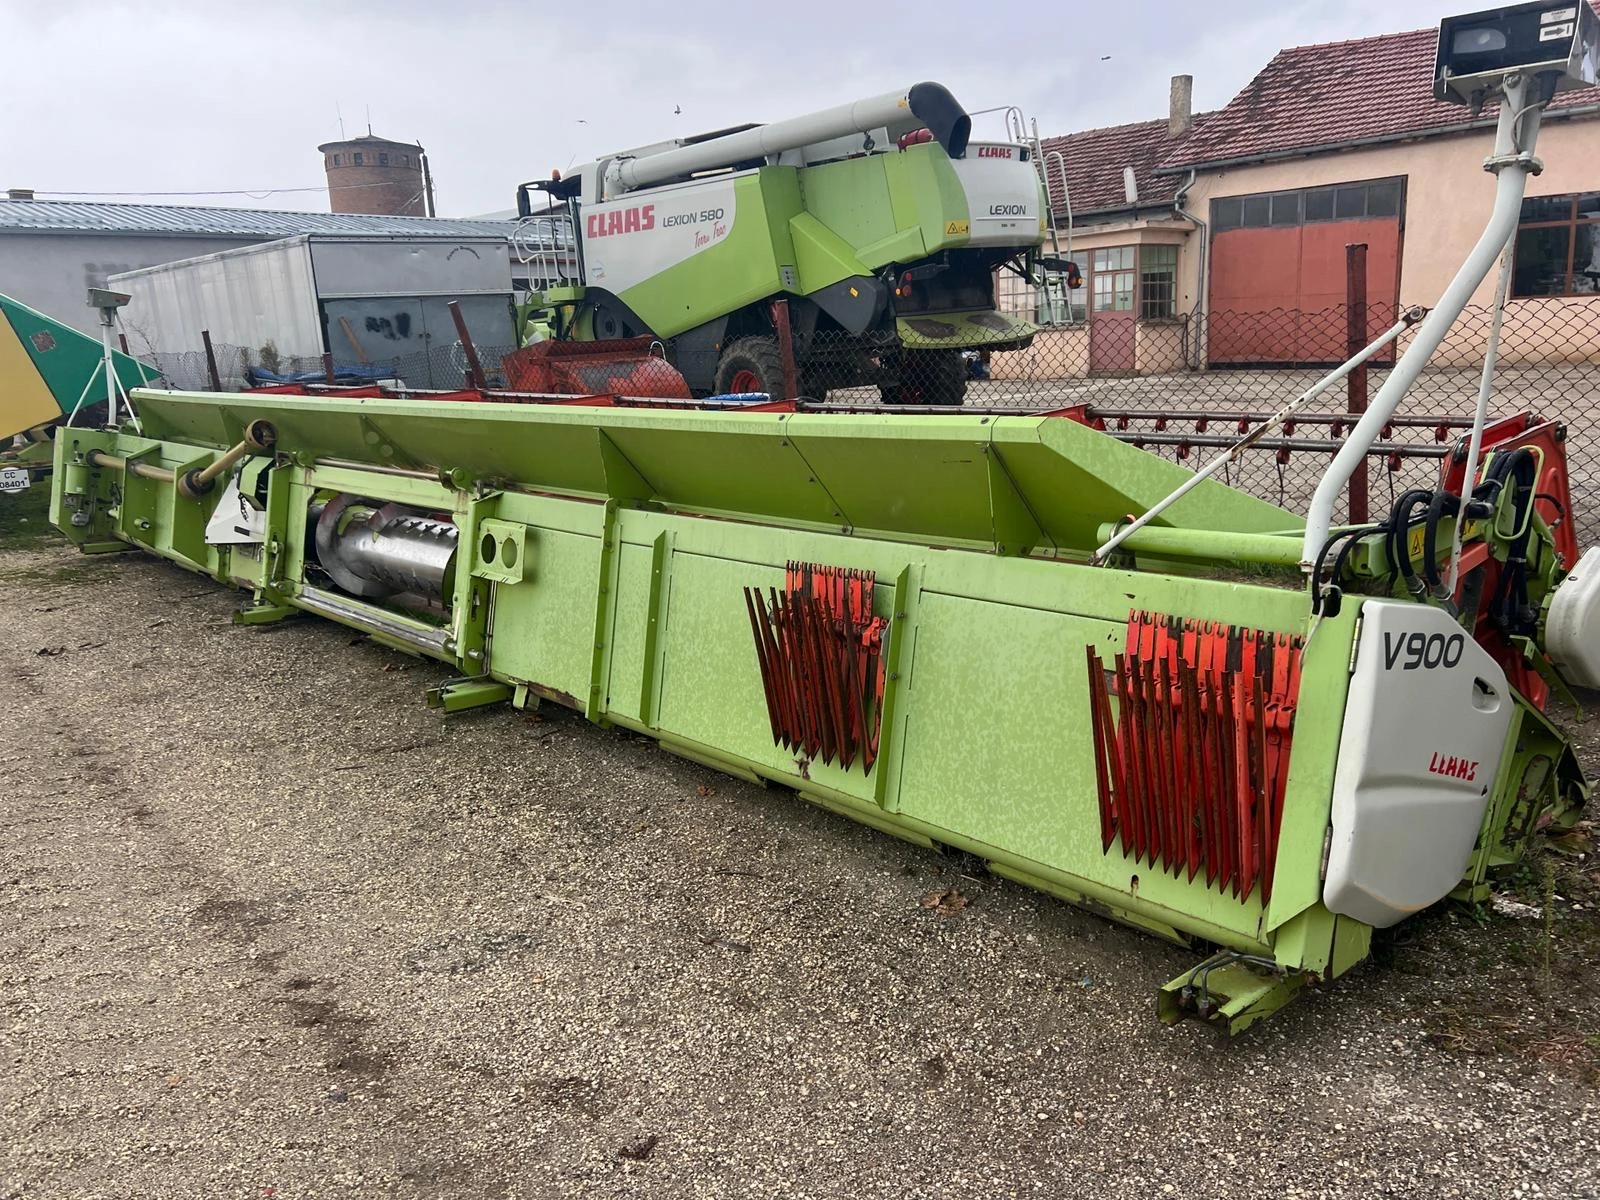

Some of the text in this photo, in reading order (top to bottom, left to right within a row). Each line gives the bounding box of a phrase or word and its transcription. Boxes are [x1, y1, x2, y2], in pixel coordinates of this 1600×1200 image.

[978, 147, 1013, 159] CLAAS
[662, 208, 724, 228] LEXION 580
[989, 205, 1027, 215] LEXION
[587, 205, 655, 239] CLAAS
[1384, 632, 1465, 670] V900
